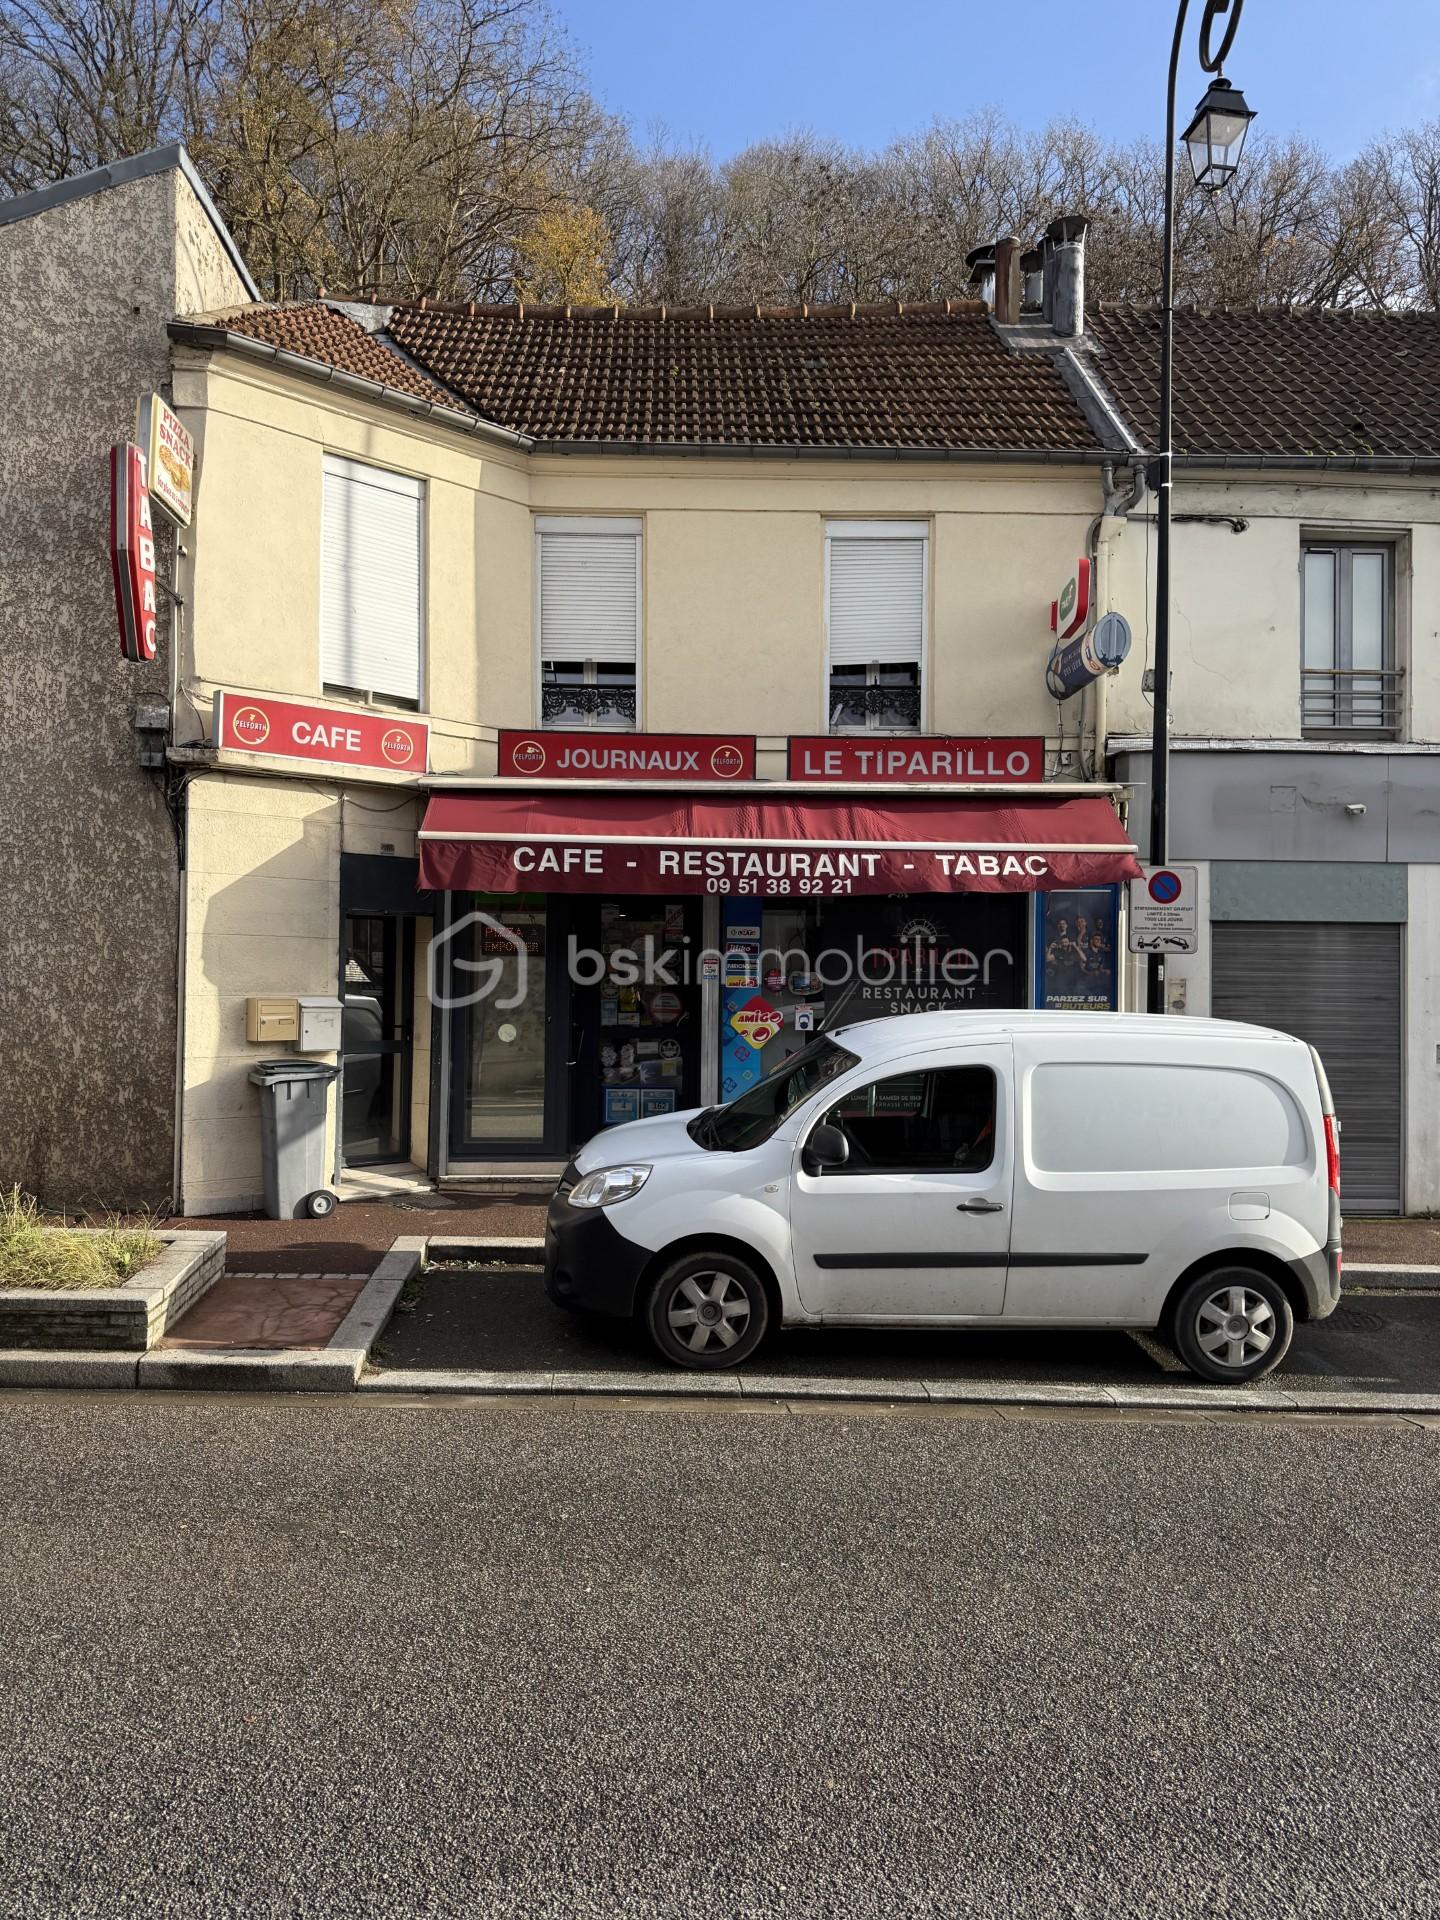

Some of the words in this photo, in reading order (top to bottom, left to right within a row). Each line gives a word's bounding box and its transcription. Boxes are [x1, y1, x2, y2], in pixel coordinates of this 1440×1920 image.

[163, 407, 190, 450] PIZZA
[159, 423, 191, 470] SNACK
[136, 453, 156, 653] TABAC
[235, 719, 267, 732] PELFORTH
[291, 721, 362, 752] CAFE
[383, 741, 411, 752] PELFORTH
[513, 753, 543, 761] PELFORTH
[556, 748, 700, 771] JOURNAUX
[804, 750, 842, 775] LE
[855, 750, 1031, 776] TIPARILLO
[513, 846, 604, 874] CAFE
[659, 850, 881, 877] RESTAURANT
[935, 855, 1049, 876] TABAC
[706, 877, 730, 894] 09
[738, 878, 758, 894] 51
[766, 878, 791, 894] 38
[799, 879, 824, 894] 92
[831, 879, 852, 894] 21
[485, 927, 524, 938] PIZZA
[862, 987, 976, 1000] RESTAURANT
[890, 1001, 947, 1014] SNACK
[1062, 1002, 1111, 1010] BUTEURS
